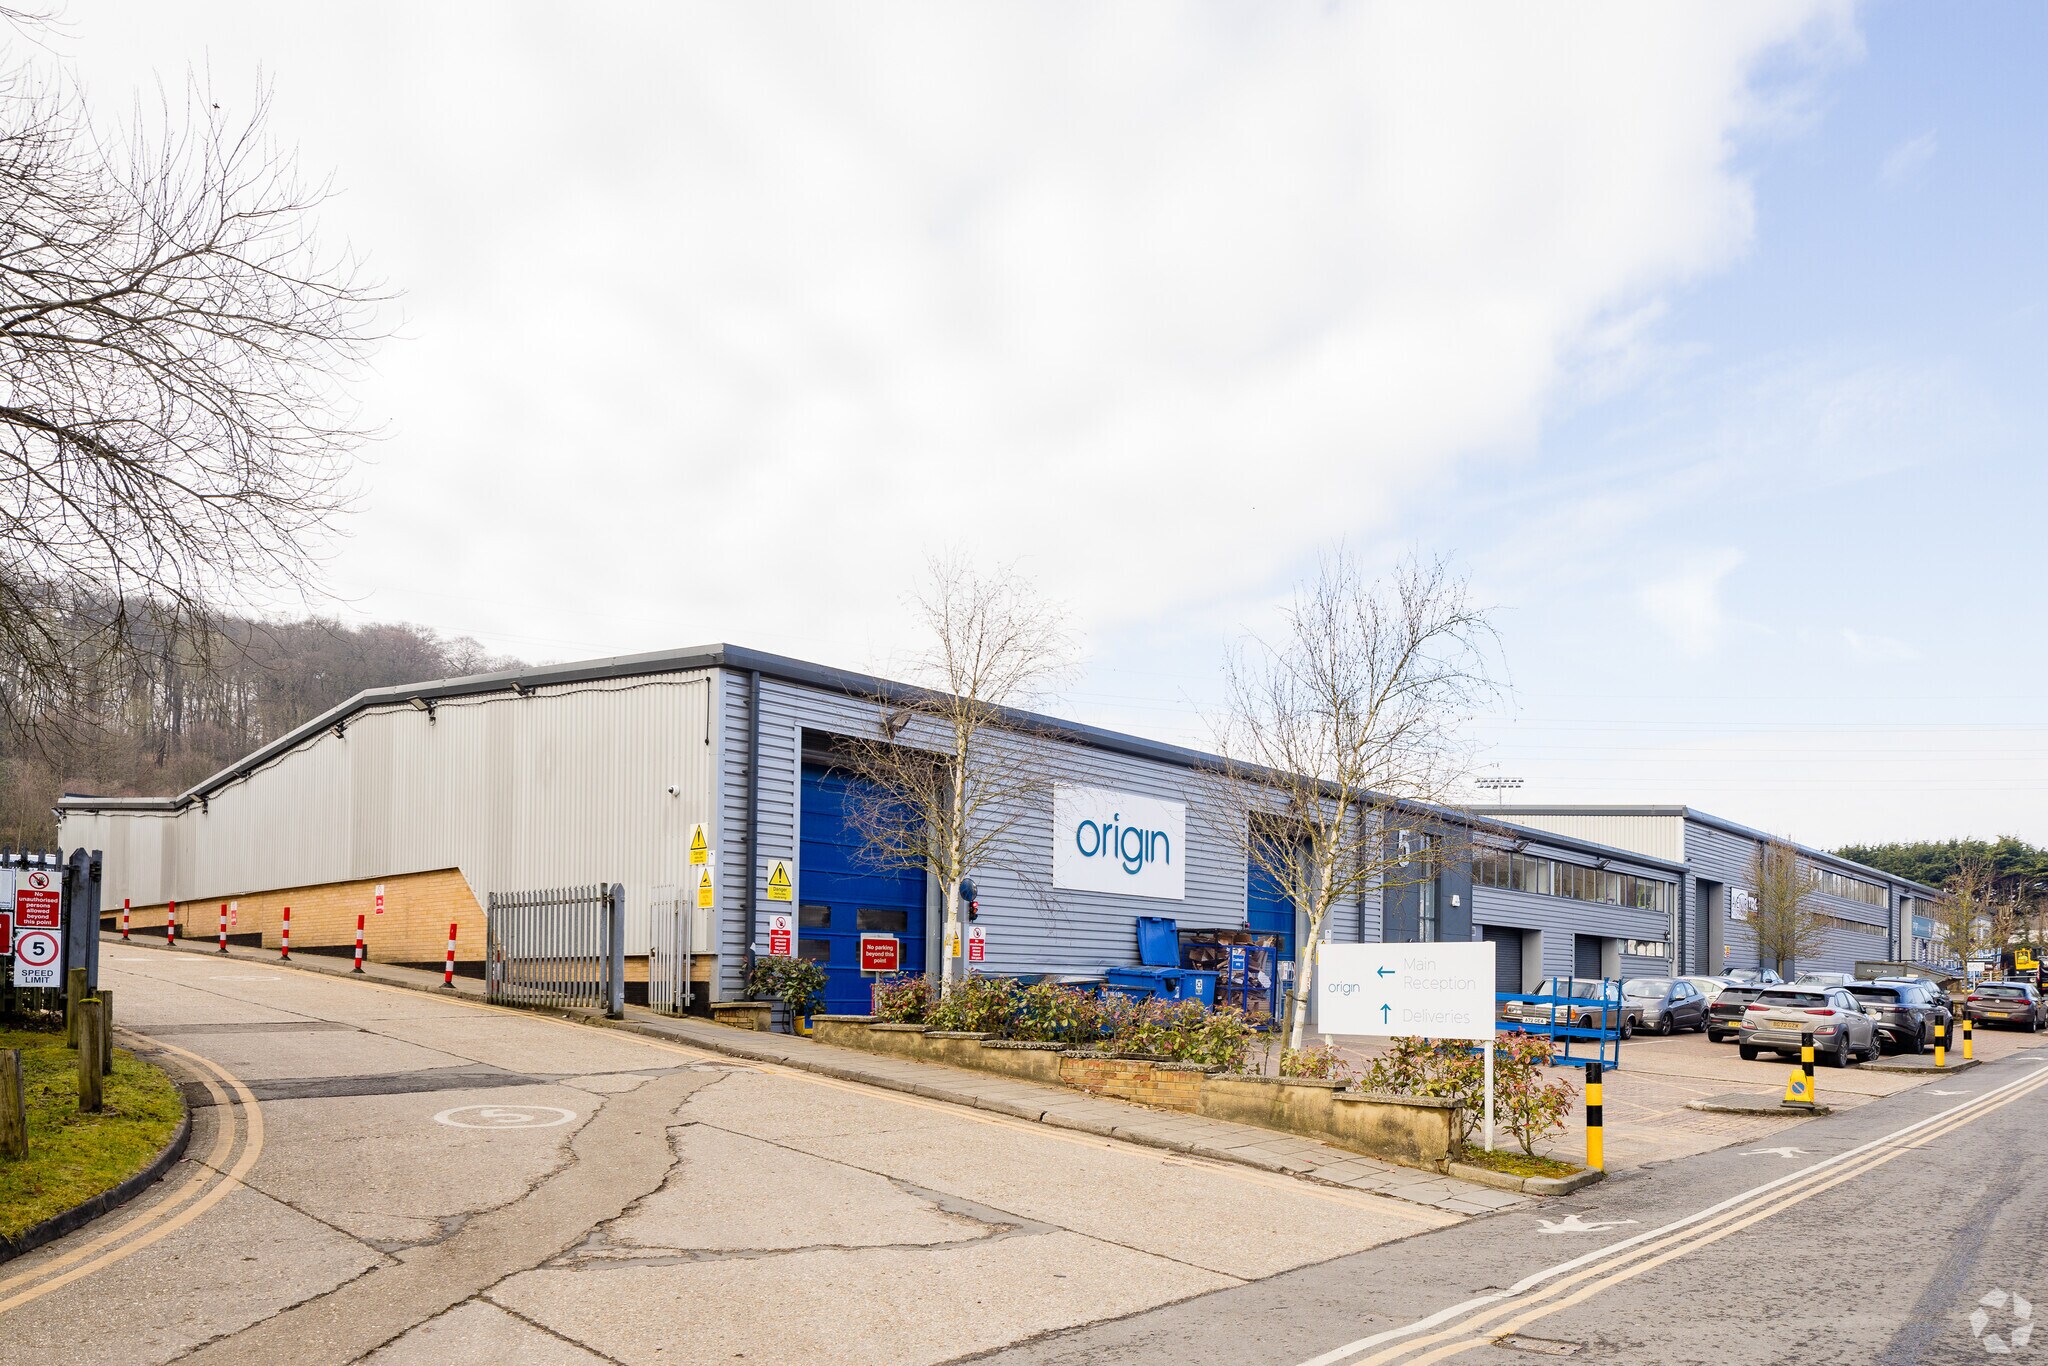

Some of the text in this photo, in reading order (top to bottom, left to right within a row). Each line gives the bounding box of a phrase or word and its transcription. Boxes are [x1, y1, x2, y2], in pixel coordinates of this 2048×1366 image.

[1076, 812, 1170, 875] origin
[32, 941, 45, 956] 5
[865, 950, 884, 958] beyond
[875, 944, 894, 952] parking
[1403, 957, 1437, 972] Main
[21, 969, 54, 977] SPEED
[24, 976, 50, 984] LIMIT
[1328, 981, 1361, 996] origin
[1403, 975, 1476, 993] Reception
[1402, 1008, 1471, 1025] Deliveries
